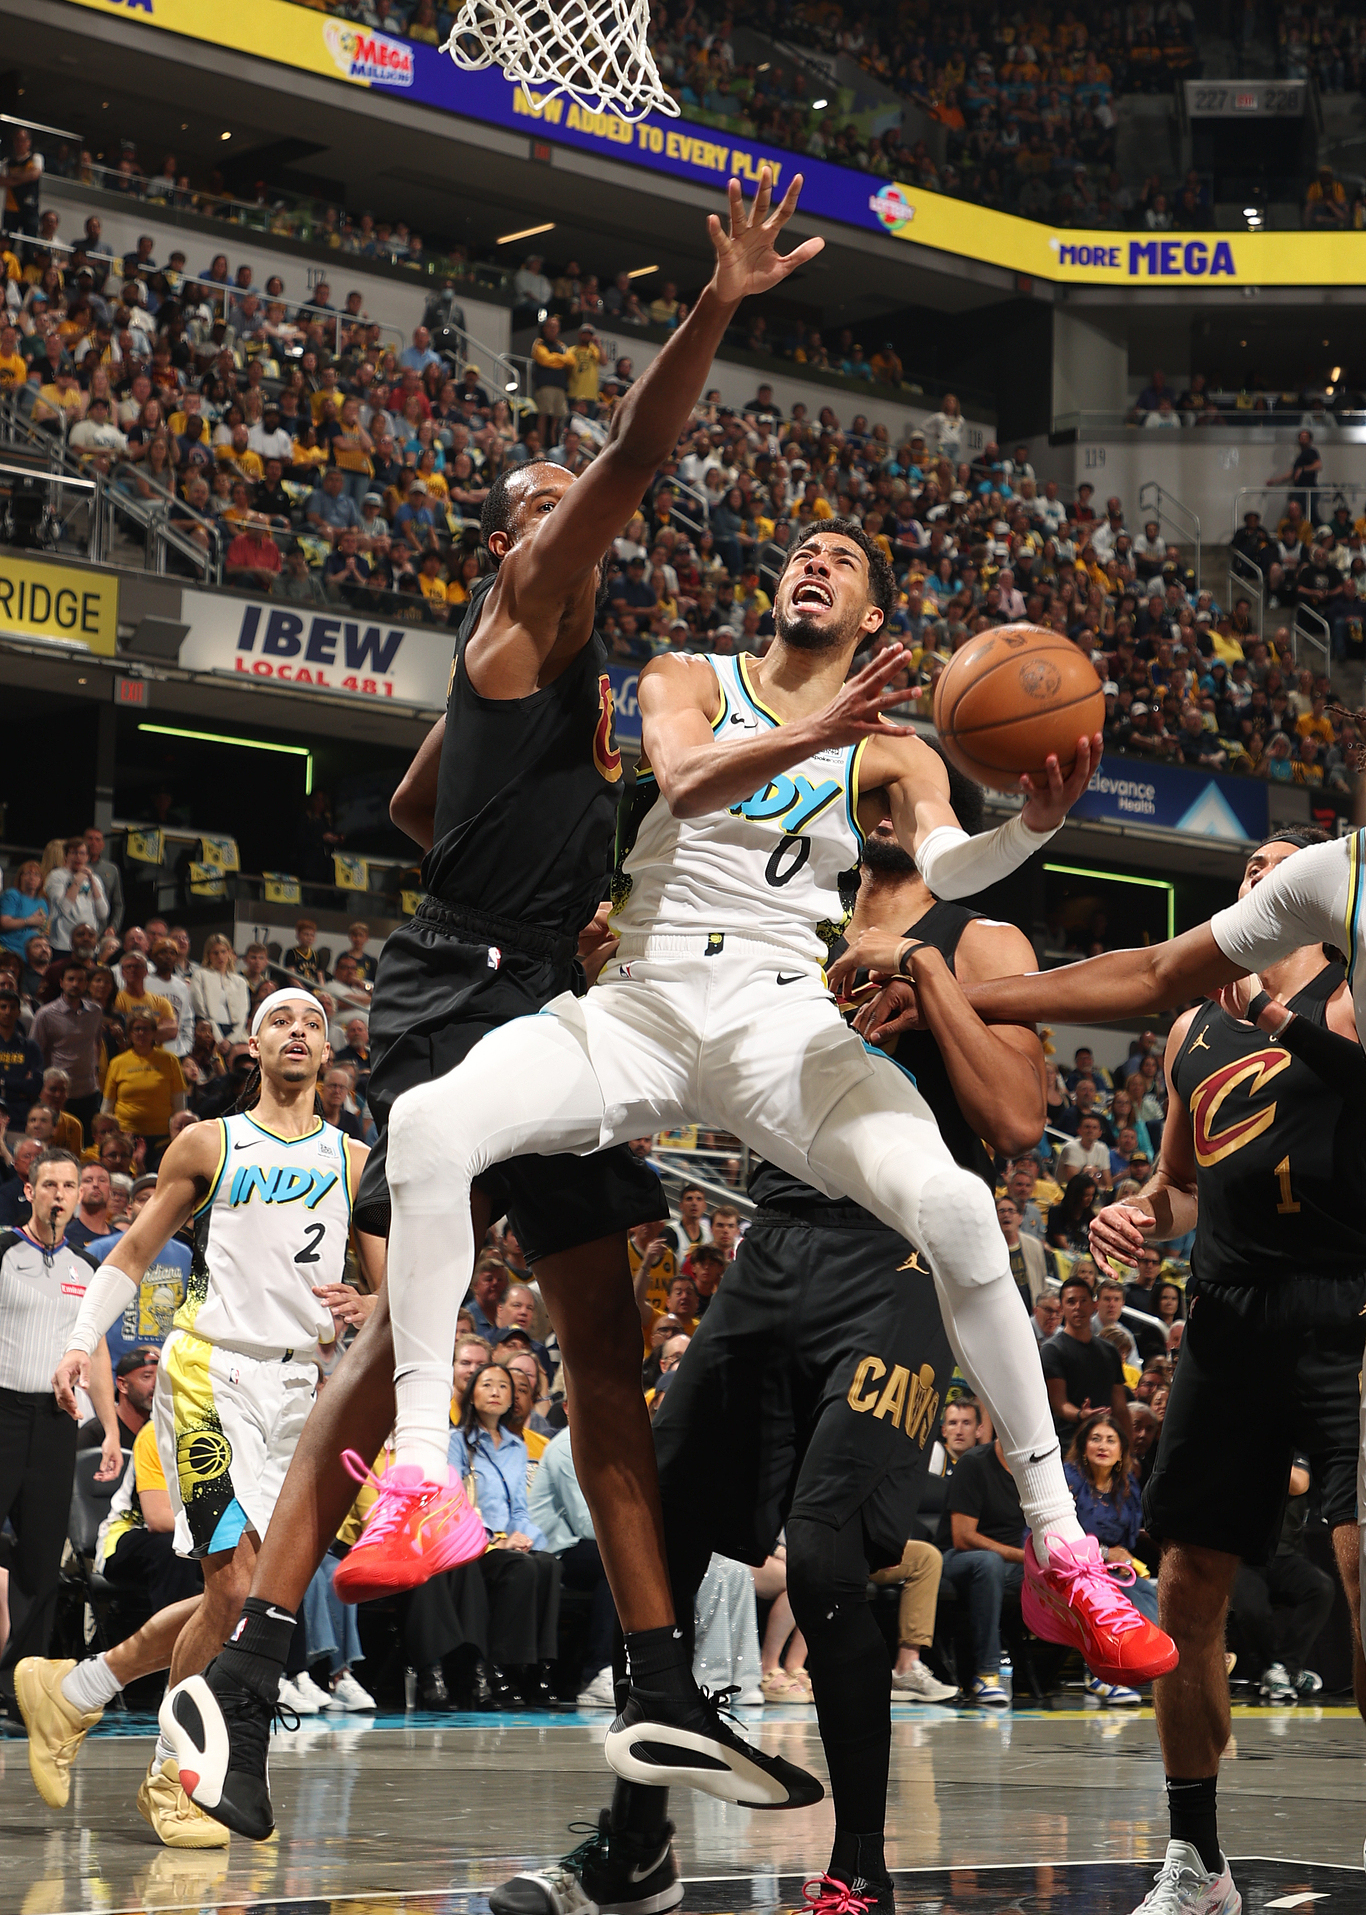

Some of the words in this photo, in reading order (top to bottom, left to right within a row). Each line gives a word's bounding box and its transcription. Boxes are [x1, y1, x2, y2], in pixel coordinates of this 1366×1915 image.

[354, 34, 410, 71] MEGA
[1197, 90, 1228, 111] 227
[513, 86, 565, 125] NOW
[566, 103, 634, 145] ADDED
[636, 122, 664, 154] TO
[666, 131, 729, 172] EVERY
[731, 150, 782, 187] PLAY
[1059, 245, 1122, 267] MORE
[1129, 241, 1237, 276] MEGA
[0, 577, 101, 635] RIDGE
[238, 604, 405, 675] IBEW
[120, 681, 144, 703] EXIT
[234, 657, 331, 688] LOCAL
[341, 676, 395, 699] 481
[726, 772, 845, 836] DY
[1086, 773, 1156, 801] Elevance
[1118, 797, 1156, 815] Health
[764, 834, 812, 889] 0
[1190, 1047, 1292, 1168] C
[228, 1164, 340, 1212] INDY
[1273, 1154, 1301, 1214] 1
[293, 1222, 327, 1264] 2
[847, 1355, 940, 1451] CAVS
